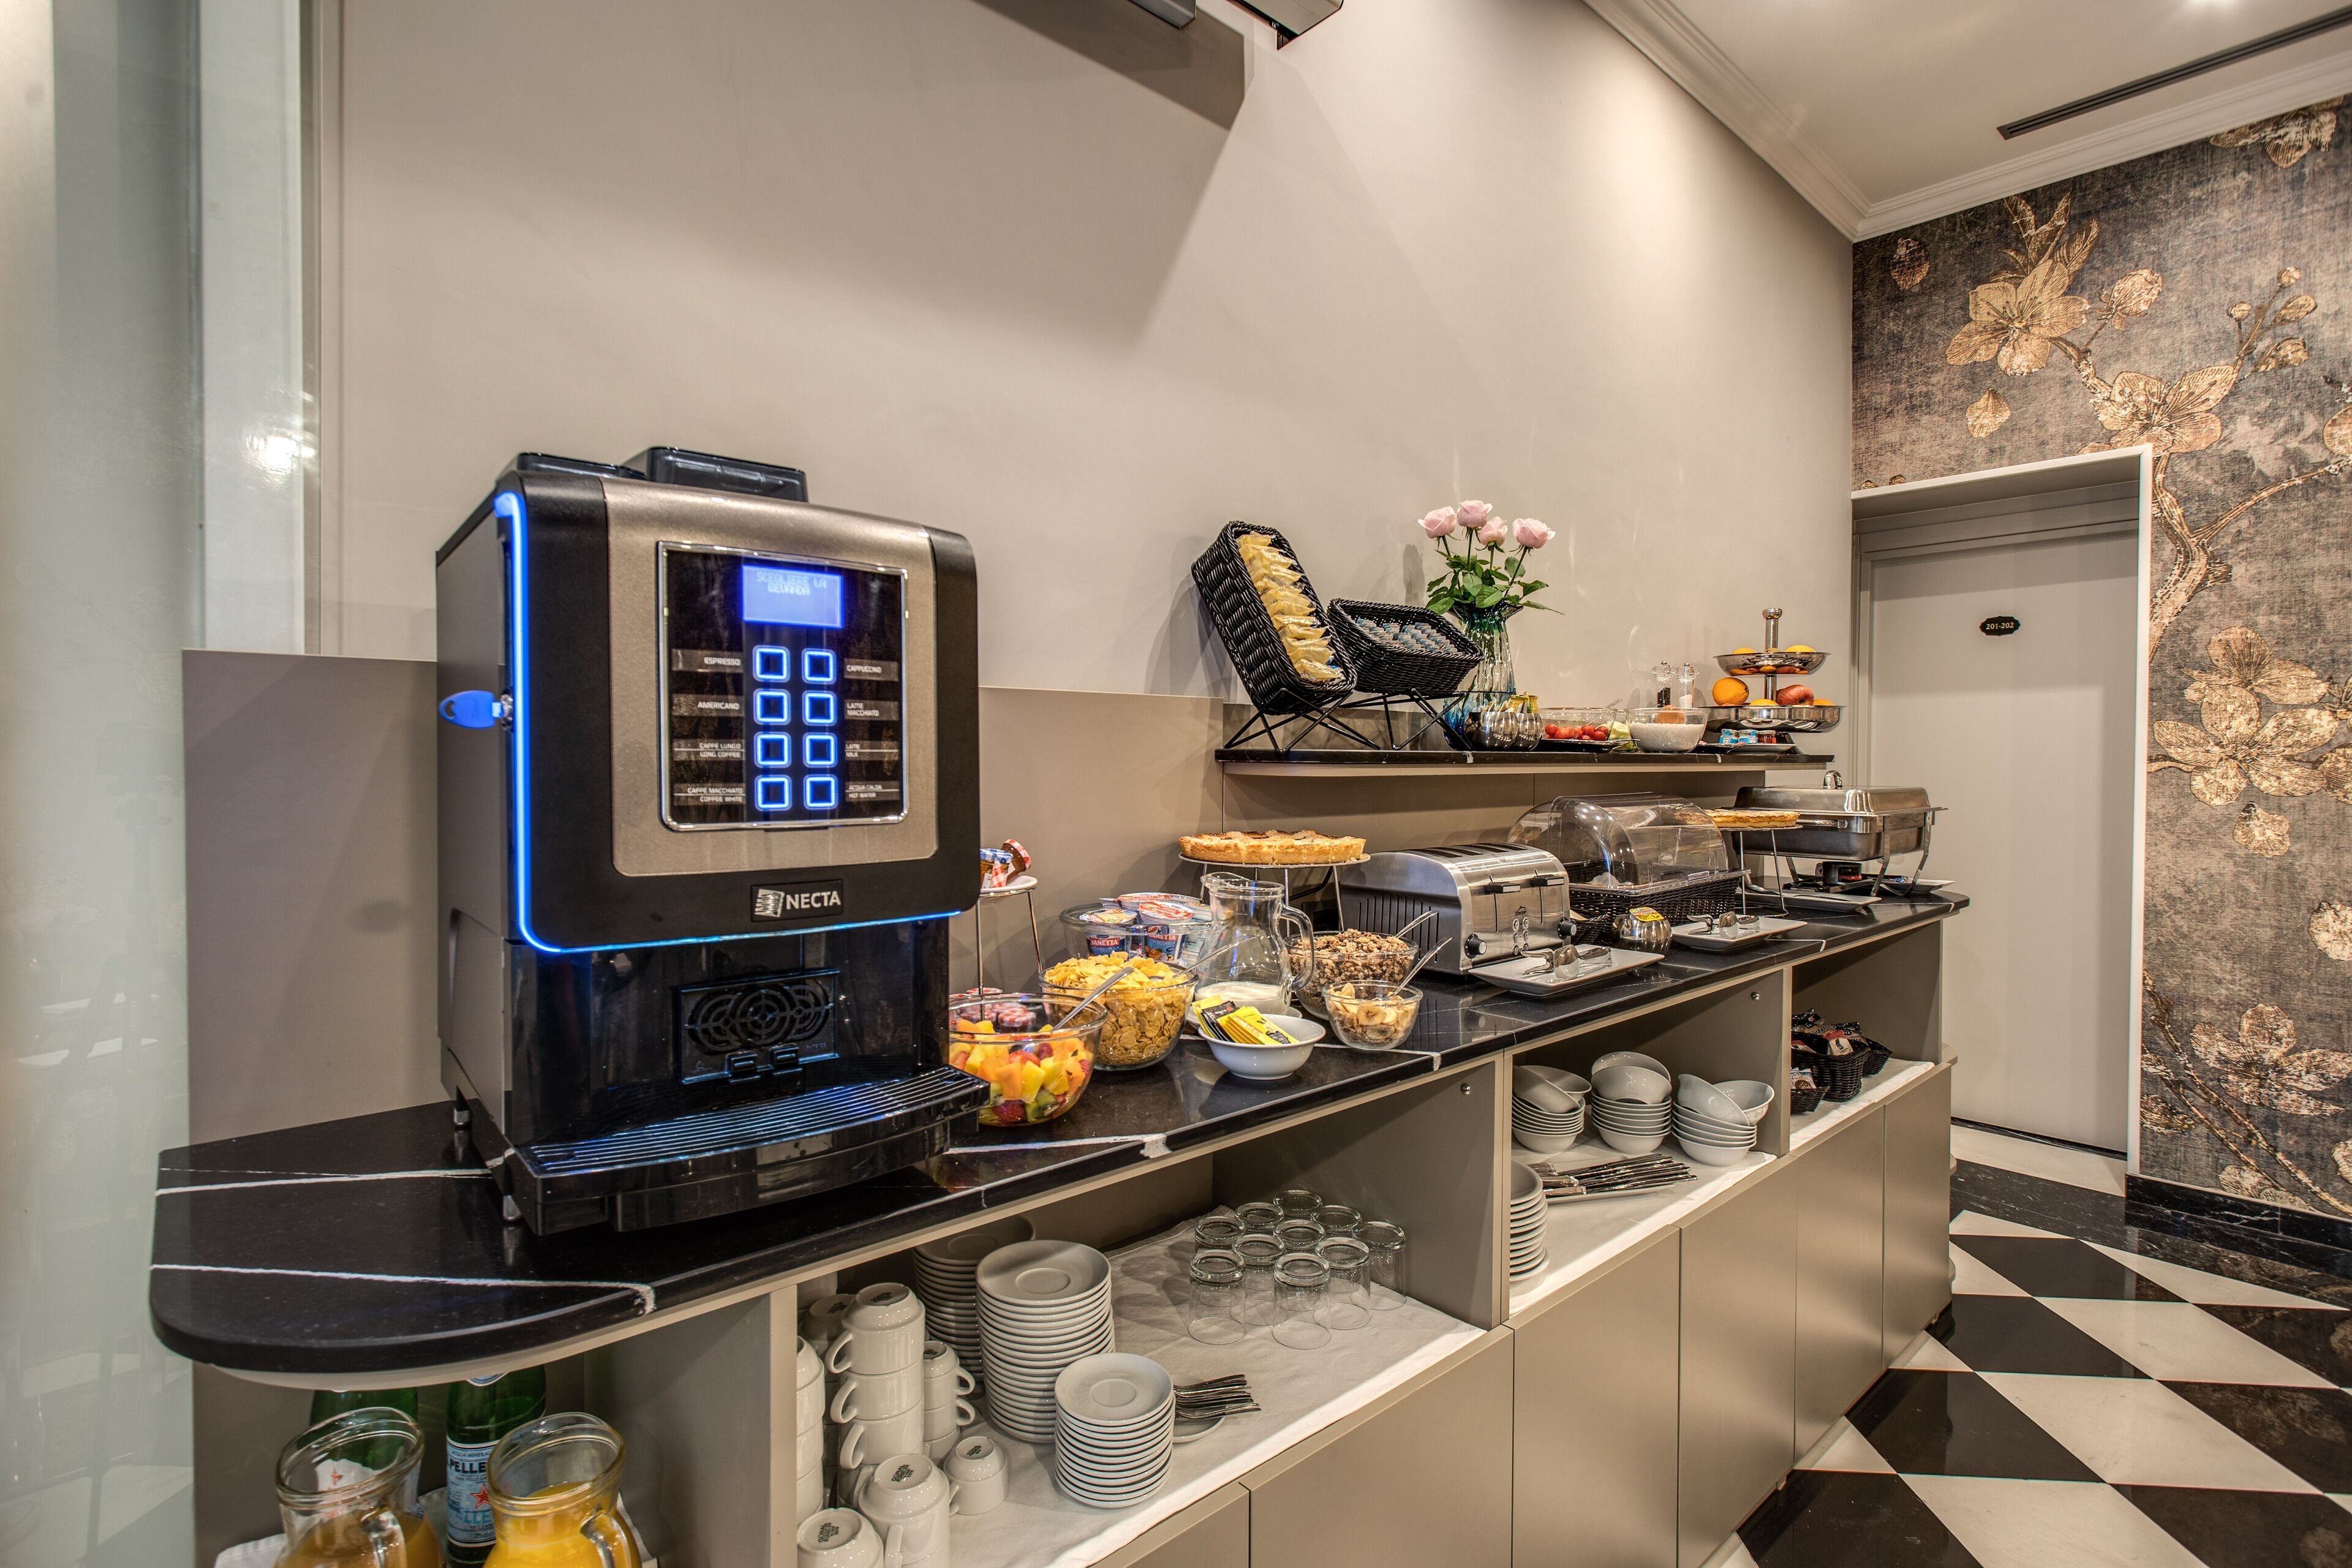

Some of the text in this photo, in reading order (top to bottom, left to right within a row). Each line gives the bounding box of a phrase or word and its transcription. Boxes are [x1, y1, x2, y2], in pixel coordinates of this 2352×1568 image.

[813, 578, 826, 588] LA
[704, 657, 741, 666] ESPRESSO
[846, 665, 882, 673] CAPPUCCINO
[697, 701, 740, 710] AMERICANO
[786, 891, 841, 910] NECTA
